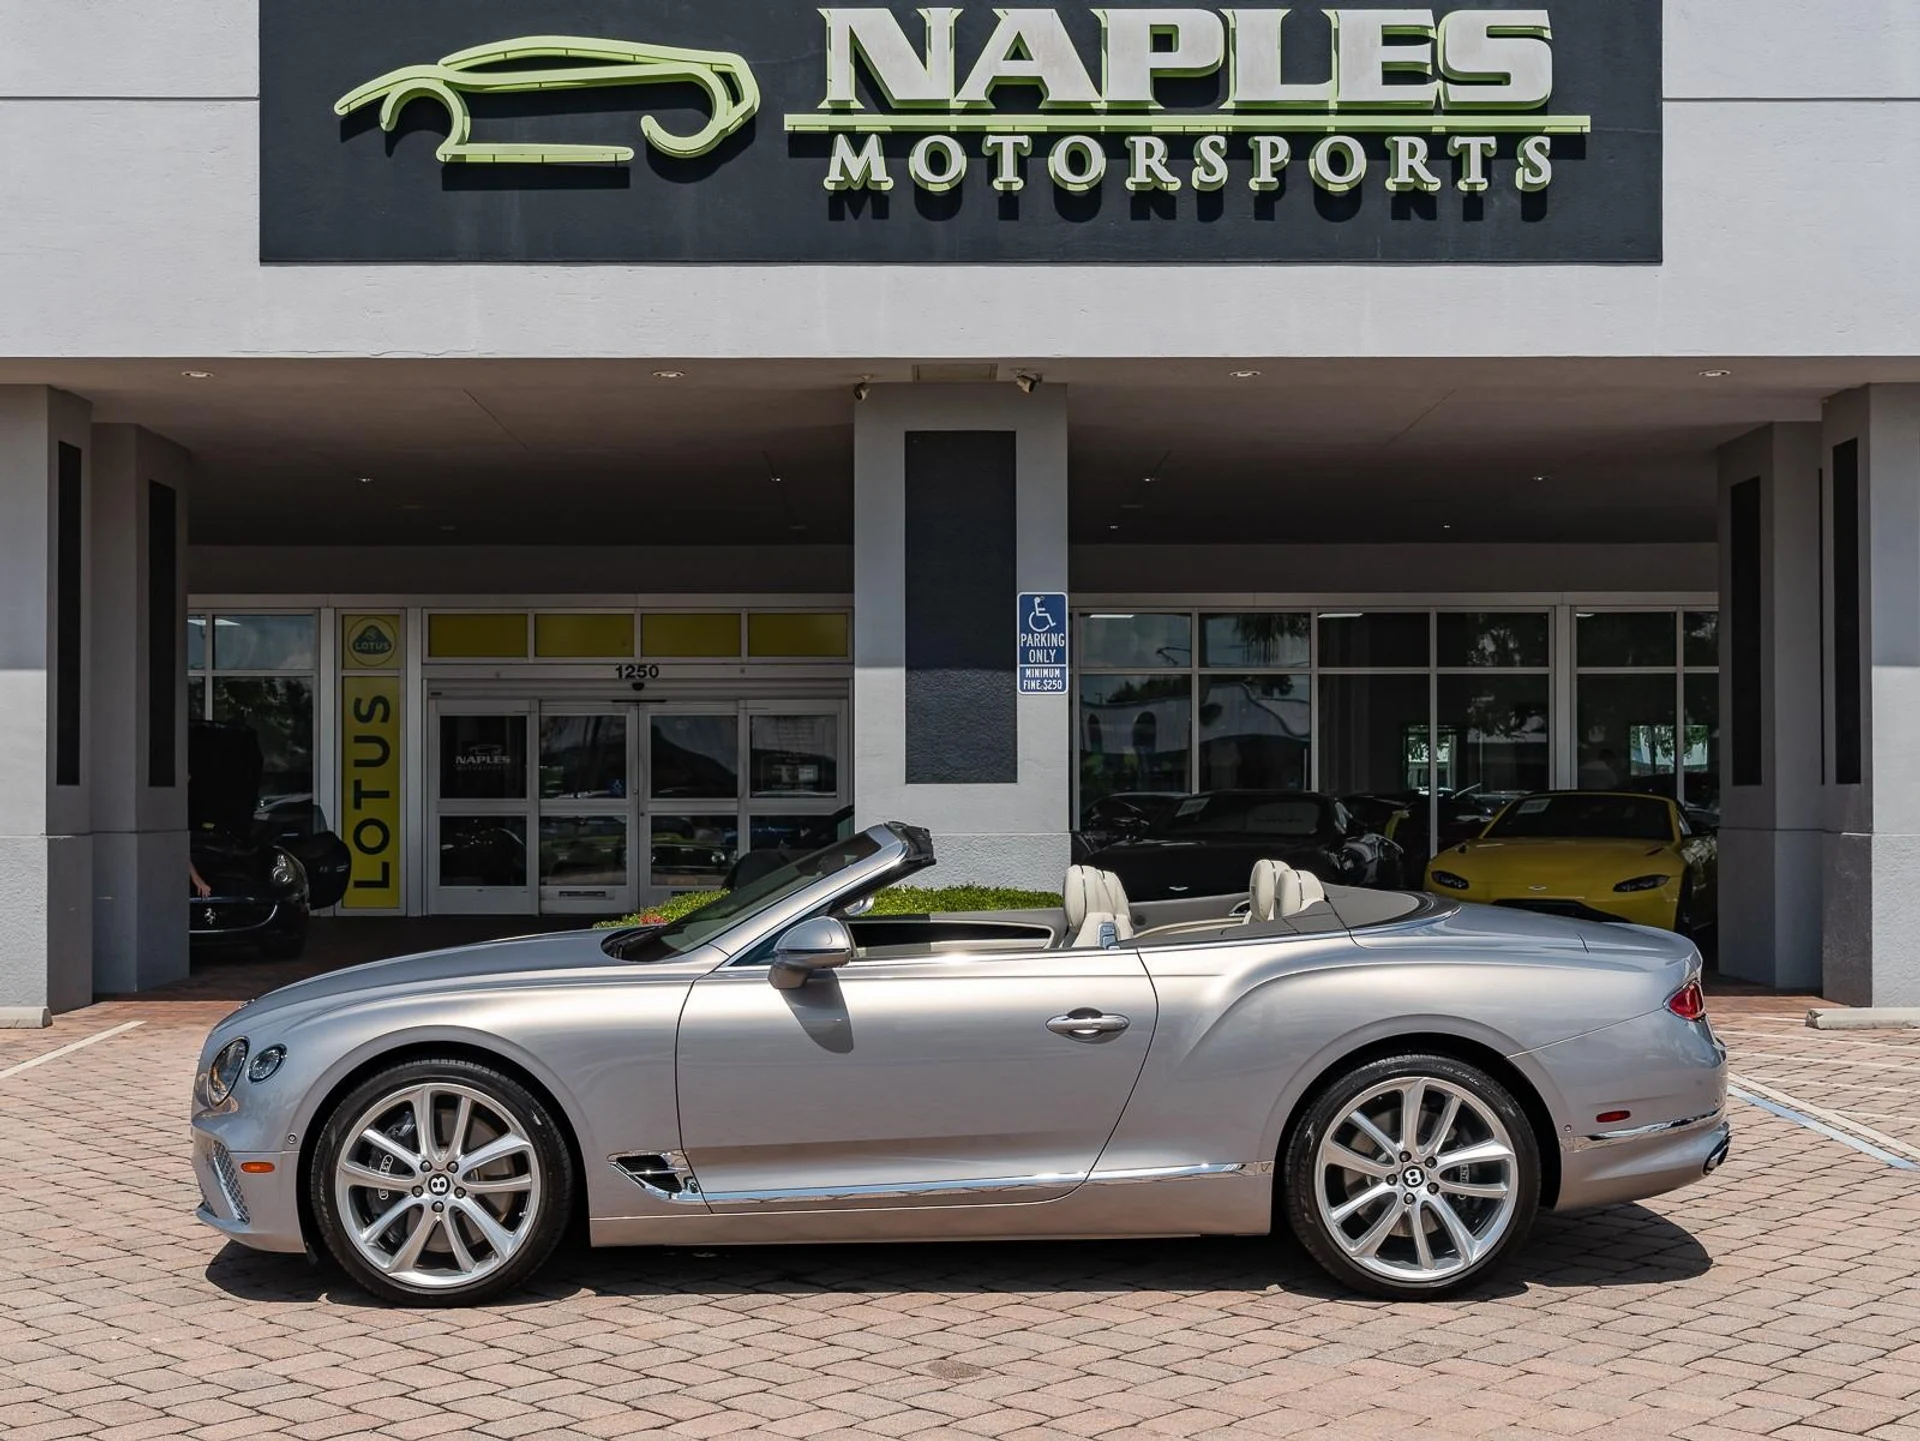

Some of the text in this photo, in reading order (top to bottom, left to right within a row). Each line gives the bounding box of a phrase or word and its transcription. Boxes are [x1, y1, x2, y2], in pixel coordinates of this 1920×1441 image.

[817, 7, 1553, 110] NAPLES
[823, 133, 1552, 192] MOTORSPORTS
[354, 641, 390, 651] LOTUS
[1020, 633, 1065, 647] PARKING
[1029, 649, 1056, 663] ONLY
[615, 664, 659, 680] 1250
[1025, 668, 1060, 678] MINIMUM
[1024, 680, 1040, 690] FINE
[353, 695, 390, 889] LOTUS
